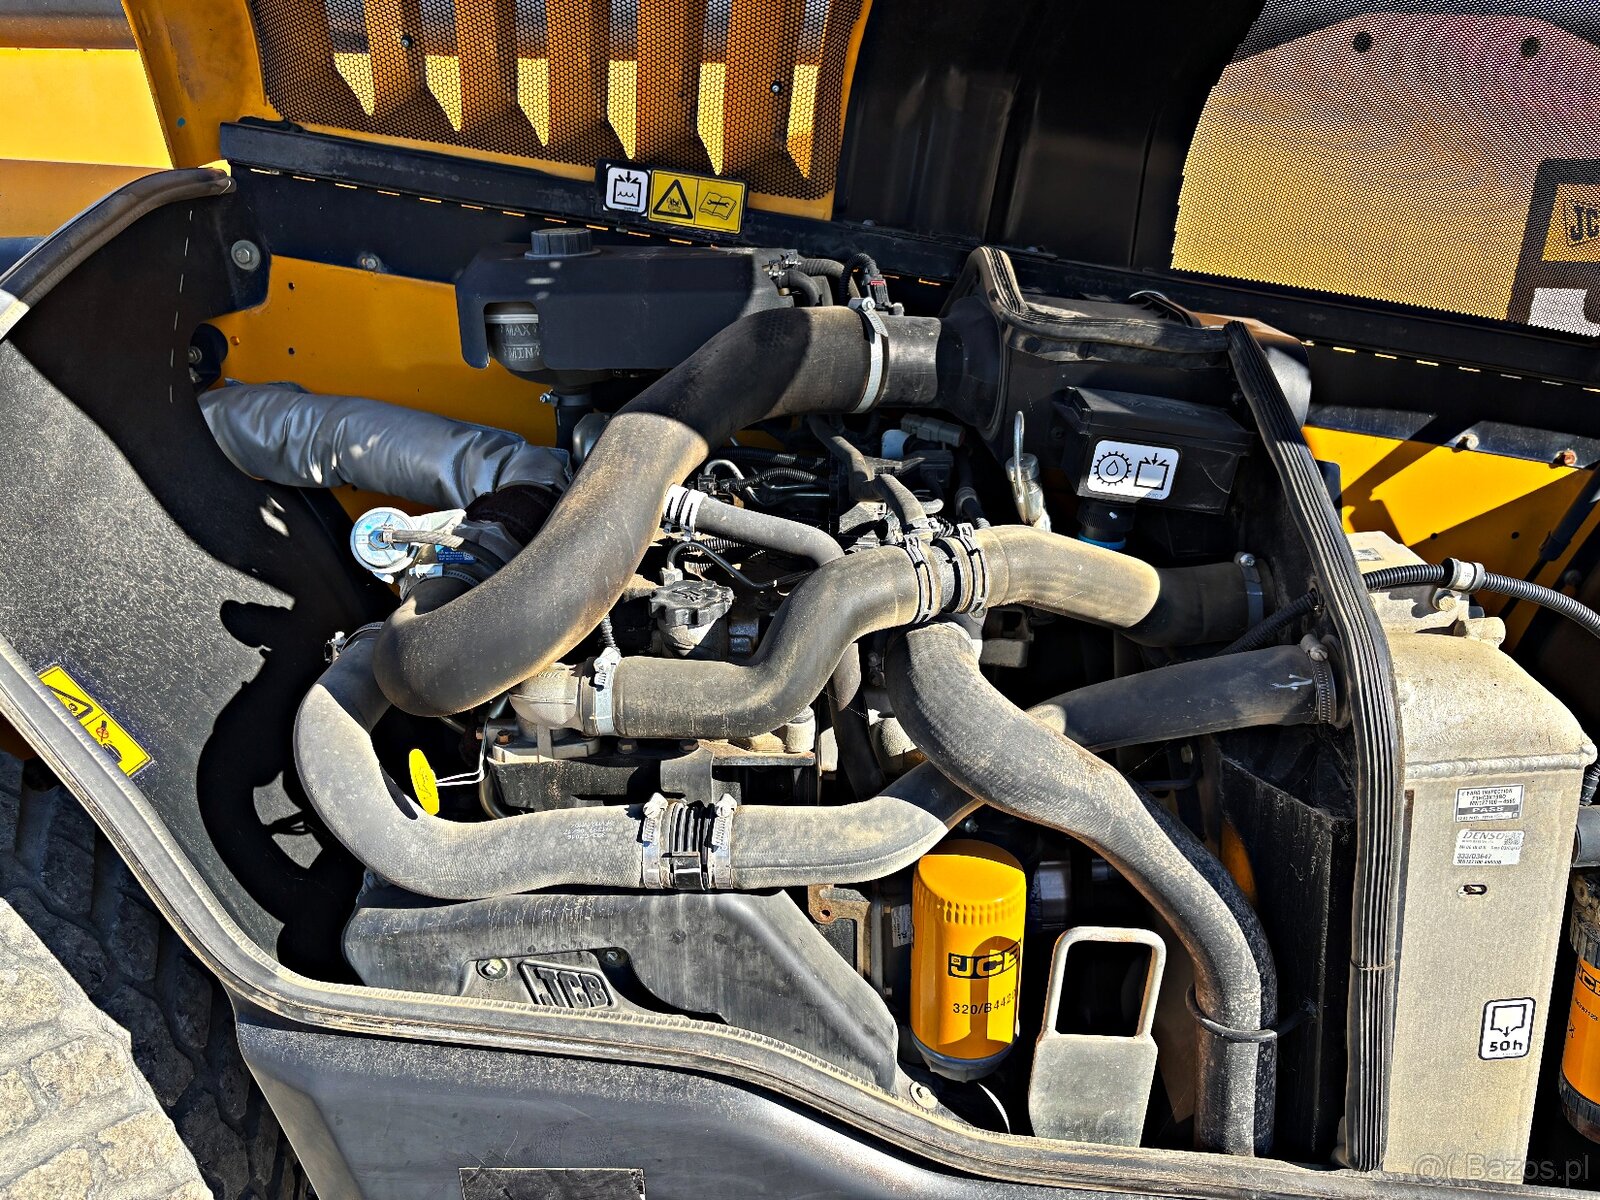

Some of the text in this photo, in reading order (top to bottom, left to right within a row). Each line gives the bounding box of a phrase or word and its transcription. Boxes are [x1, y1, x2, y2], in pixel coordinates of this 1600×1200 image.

[1570, 207, 1600, 240] JC
[505, 323, 531, 336] MAX
[508, 347, 534, 359] MIN
[1463, 831, 1505, 840] DENSO
[532, 966, 608, 1009] JCB
